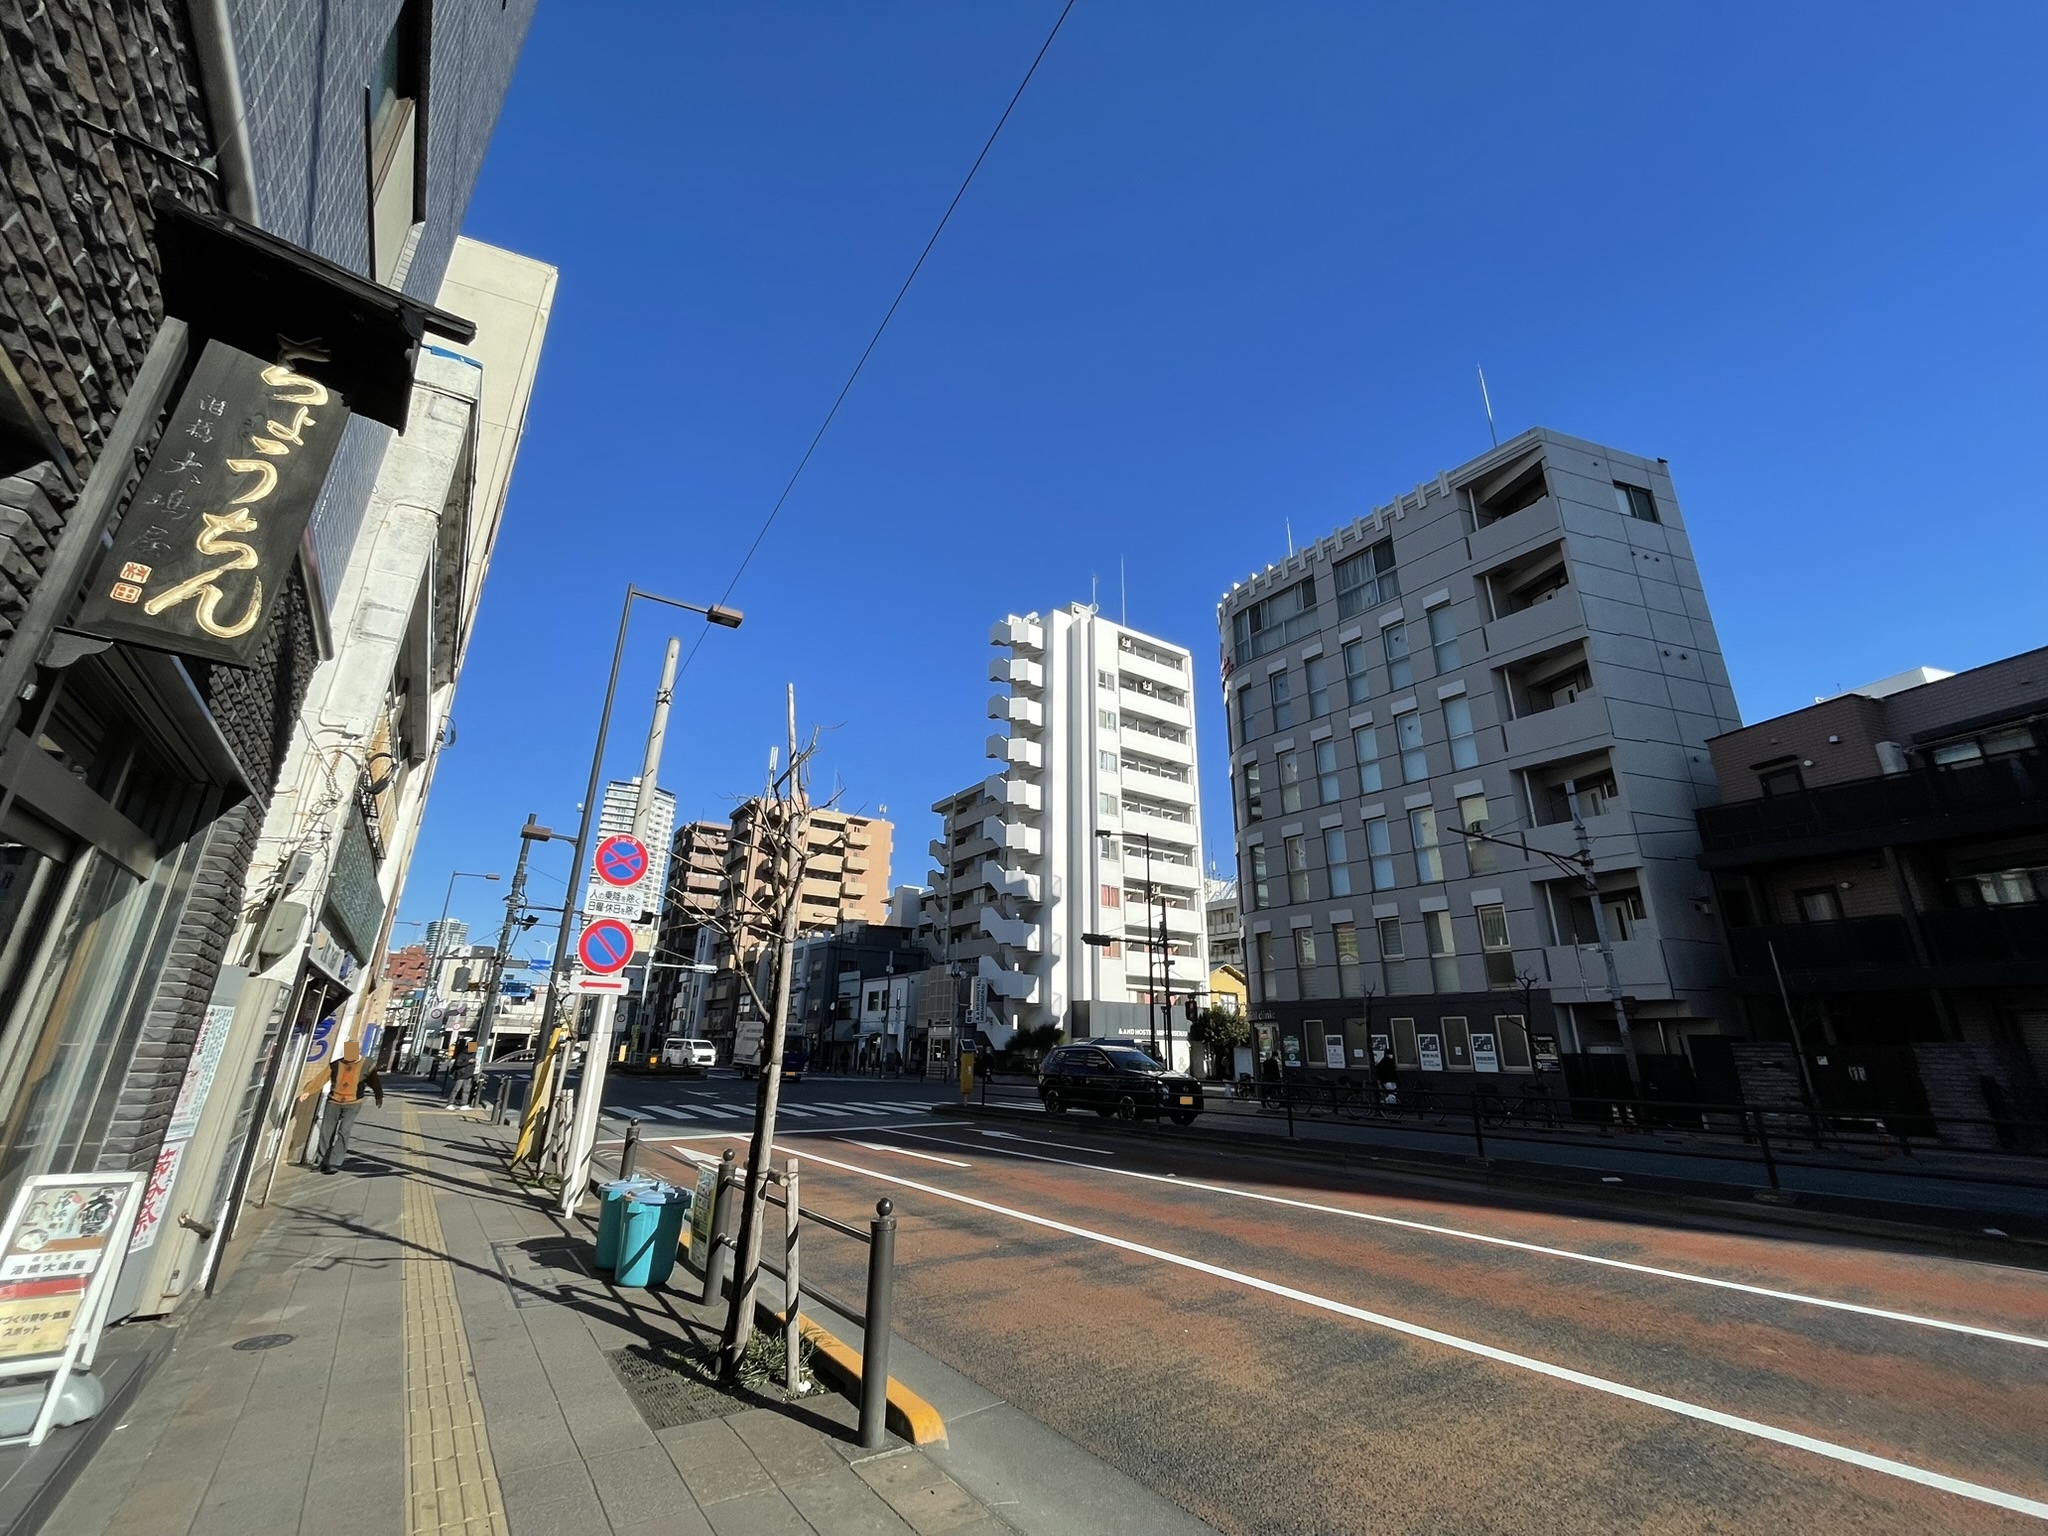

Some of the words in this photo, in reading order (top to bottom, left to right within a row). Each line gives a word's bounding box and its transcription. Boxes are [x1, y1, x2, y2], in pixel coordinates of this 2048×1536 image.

[589, 888, 641, 905] 人の乗降を除く
[3, 1325, 41, 1336] スポット
